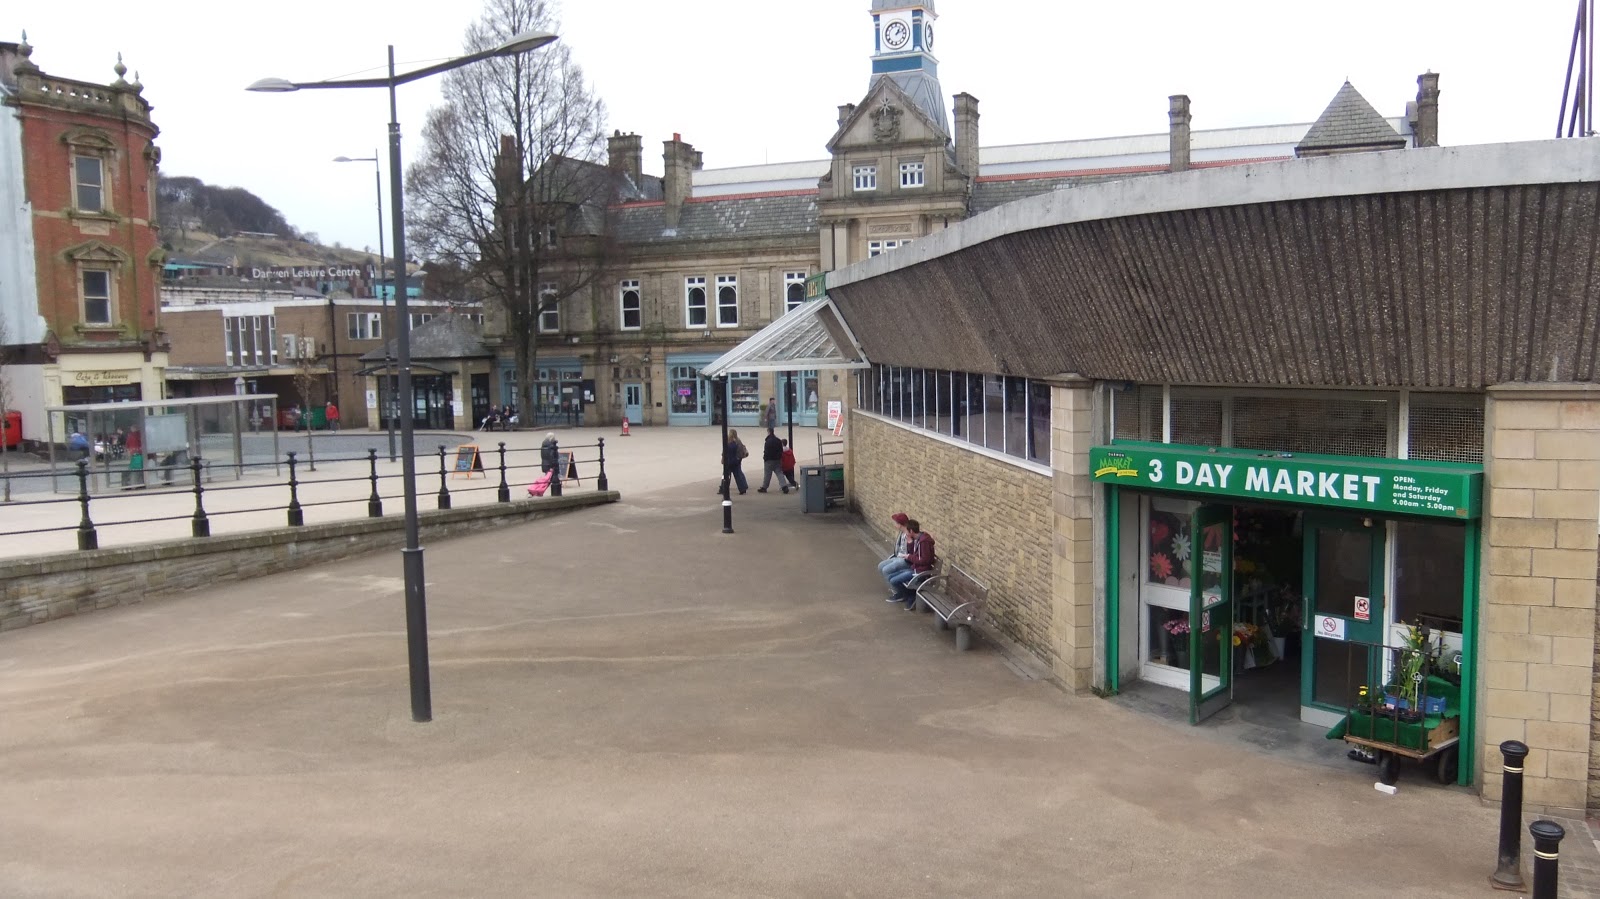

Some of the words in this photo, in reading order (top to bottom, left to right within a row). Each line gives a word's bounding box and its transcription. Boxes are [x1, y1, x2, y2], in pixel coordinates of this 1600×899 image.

[292, 267, 325, 278] Leisure
[328, 266, 361, 277] Centre
[1148, 458, 1163, 483] 3
[1176, 460, 1233, 489] DAY
[1245, 466, 1381, 503] MARKET
[1393, 475, 1416, 484] OPEN:
[1393, 483, 1423, 493] Monday,
[1425, 486, 1449, 496] Friday
[1392, 491, 1407, 499] and
[1408, 492, 1441, 502] Saturday
[1392, 499, 1419, 508] 9.00am
[1426, 502, 1454, 512] 5.00pm
